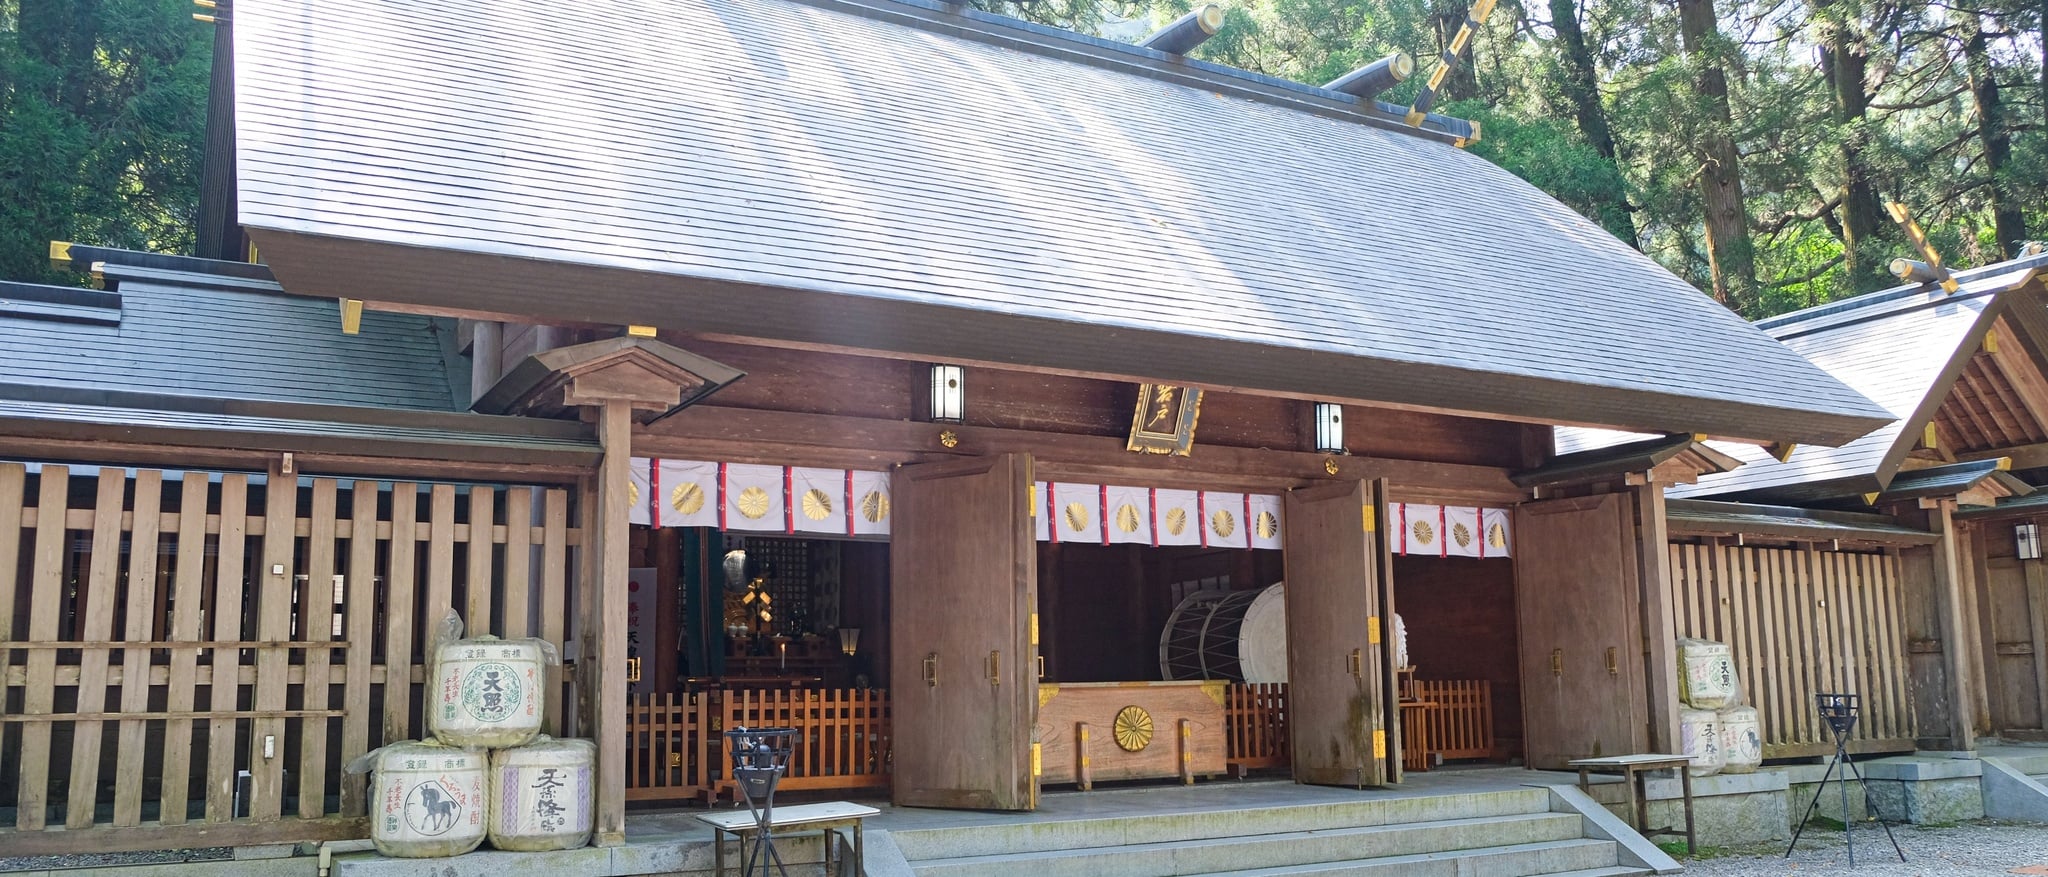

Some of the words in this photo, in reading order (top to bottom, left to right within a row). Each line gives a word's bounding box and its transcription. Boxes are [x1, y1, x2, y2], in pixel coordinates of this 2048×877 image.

[501, 648, 521, 659] 商標
[481, 671, 504, 713] 天照
[405, 759, 427, 770] 登録
[444, 758, 466, 769] 商標
[393, 778, 402, 809] 不老長生
[440, 774, 467, 806] くろうま
[470, 775, 480, 826] 麦焼酎
[531, 768, 567, 832] 天孫降臨
